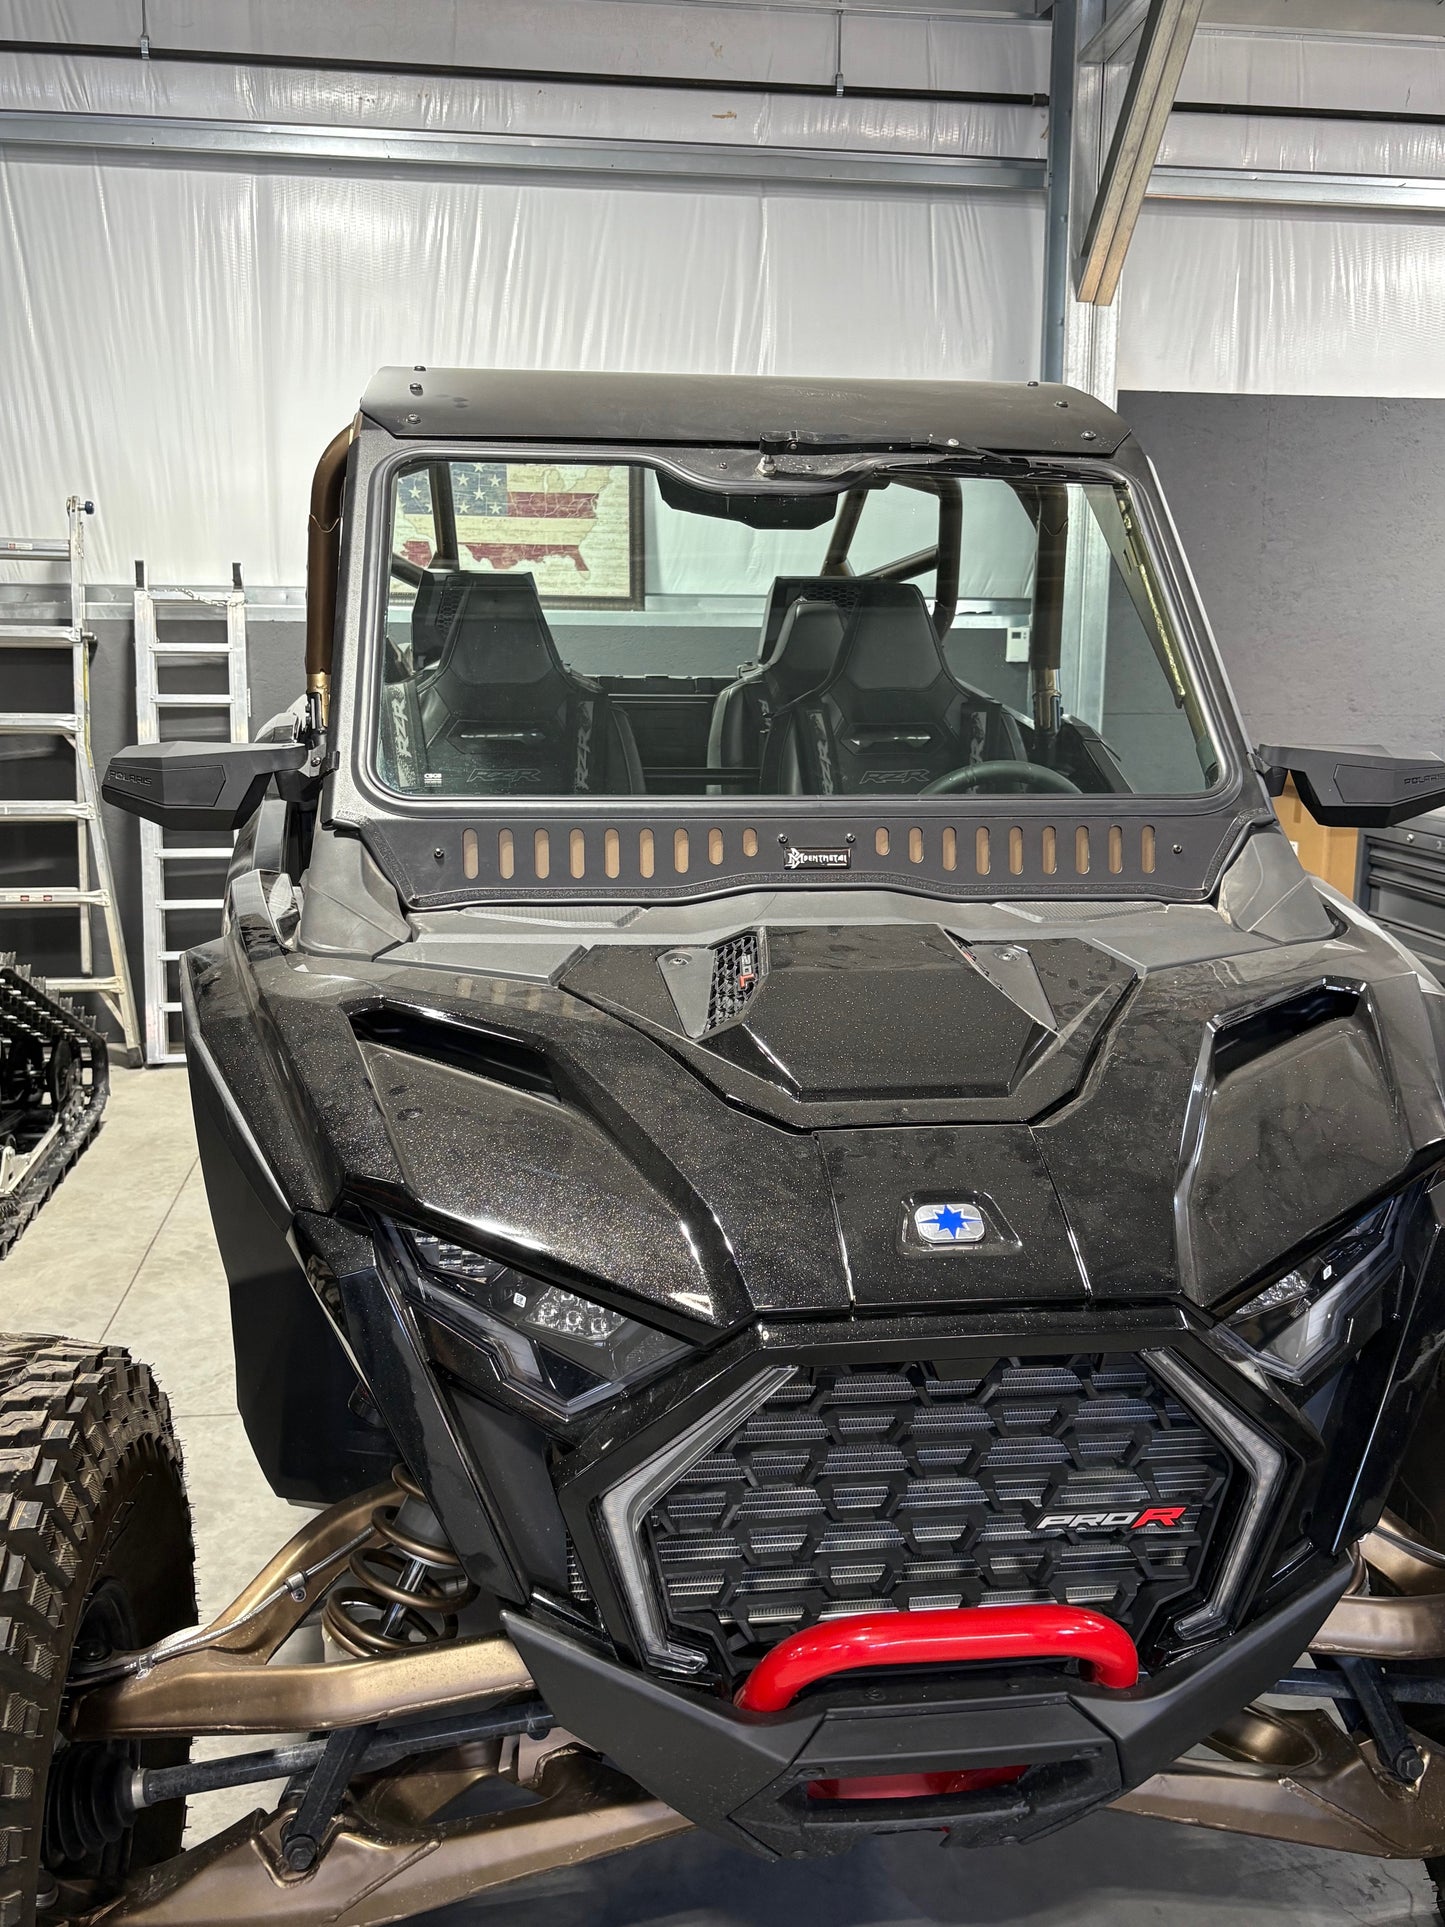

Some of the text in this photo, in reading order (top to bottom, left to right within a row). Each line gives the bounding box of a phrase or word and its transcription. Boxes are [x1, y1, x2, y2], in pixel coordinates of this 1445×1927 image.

[391, 699, 412, 757] RZR
[108, 770, 153, 787] POLARIS
[859, 768, 930, 785] RZR
